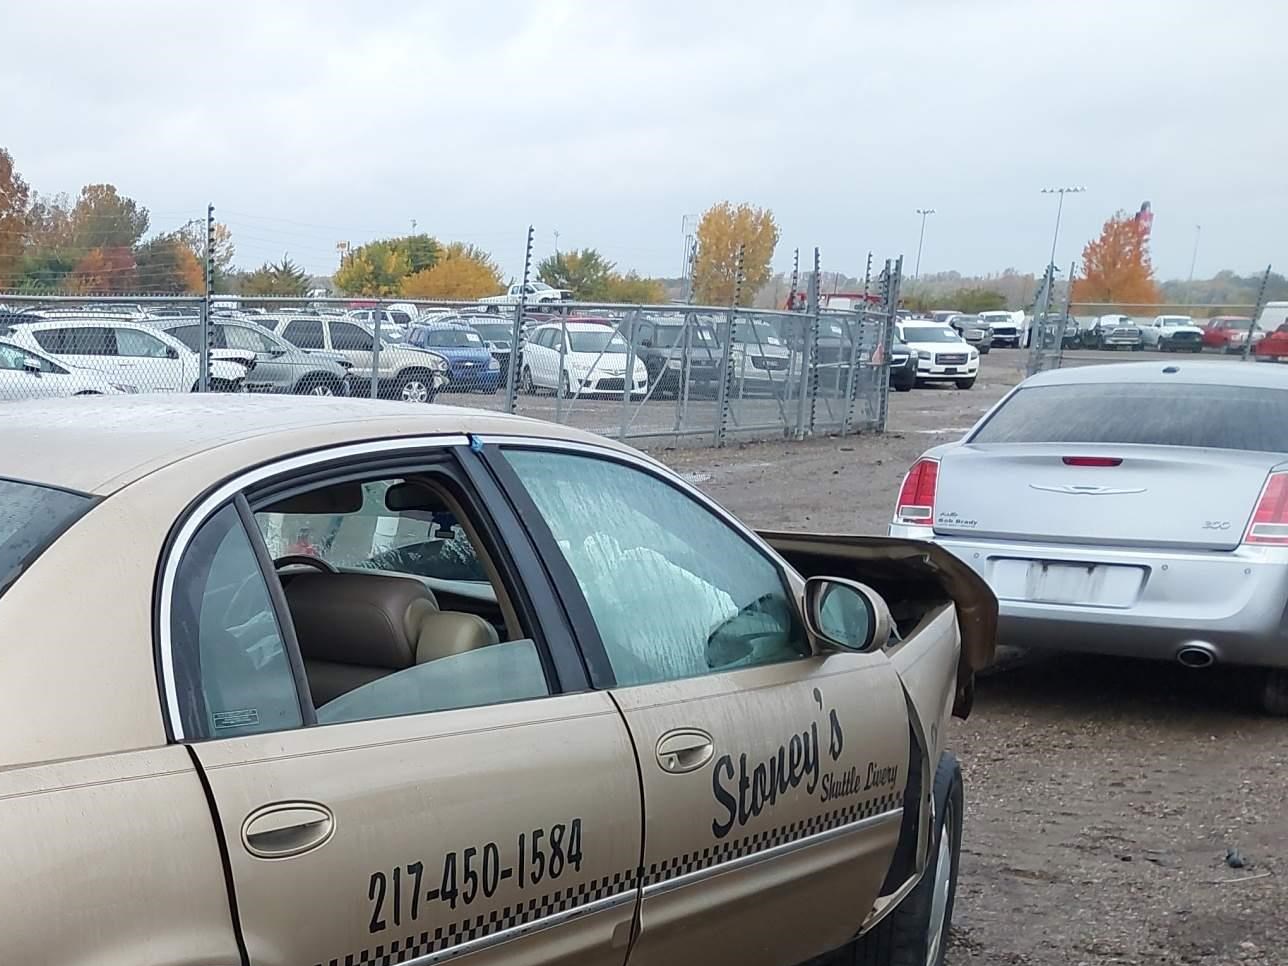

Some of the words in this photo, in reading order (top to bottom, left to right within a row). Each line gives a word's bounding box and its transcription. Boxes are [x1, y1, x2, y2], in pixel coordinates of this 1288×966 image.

[711, 687, 844, 838] Stoney's
[820, 766, 861, 803] Shuttle
[864, 761, 899, 790] Livery
[368, 818, 583, 934] 217-450-1584
